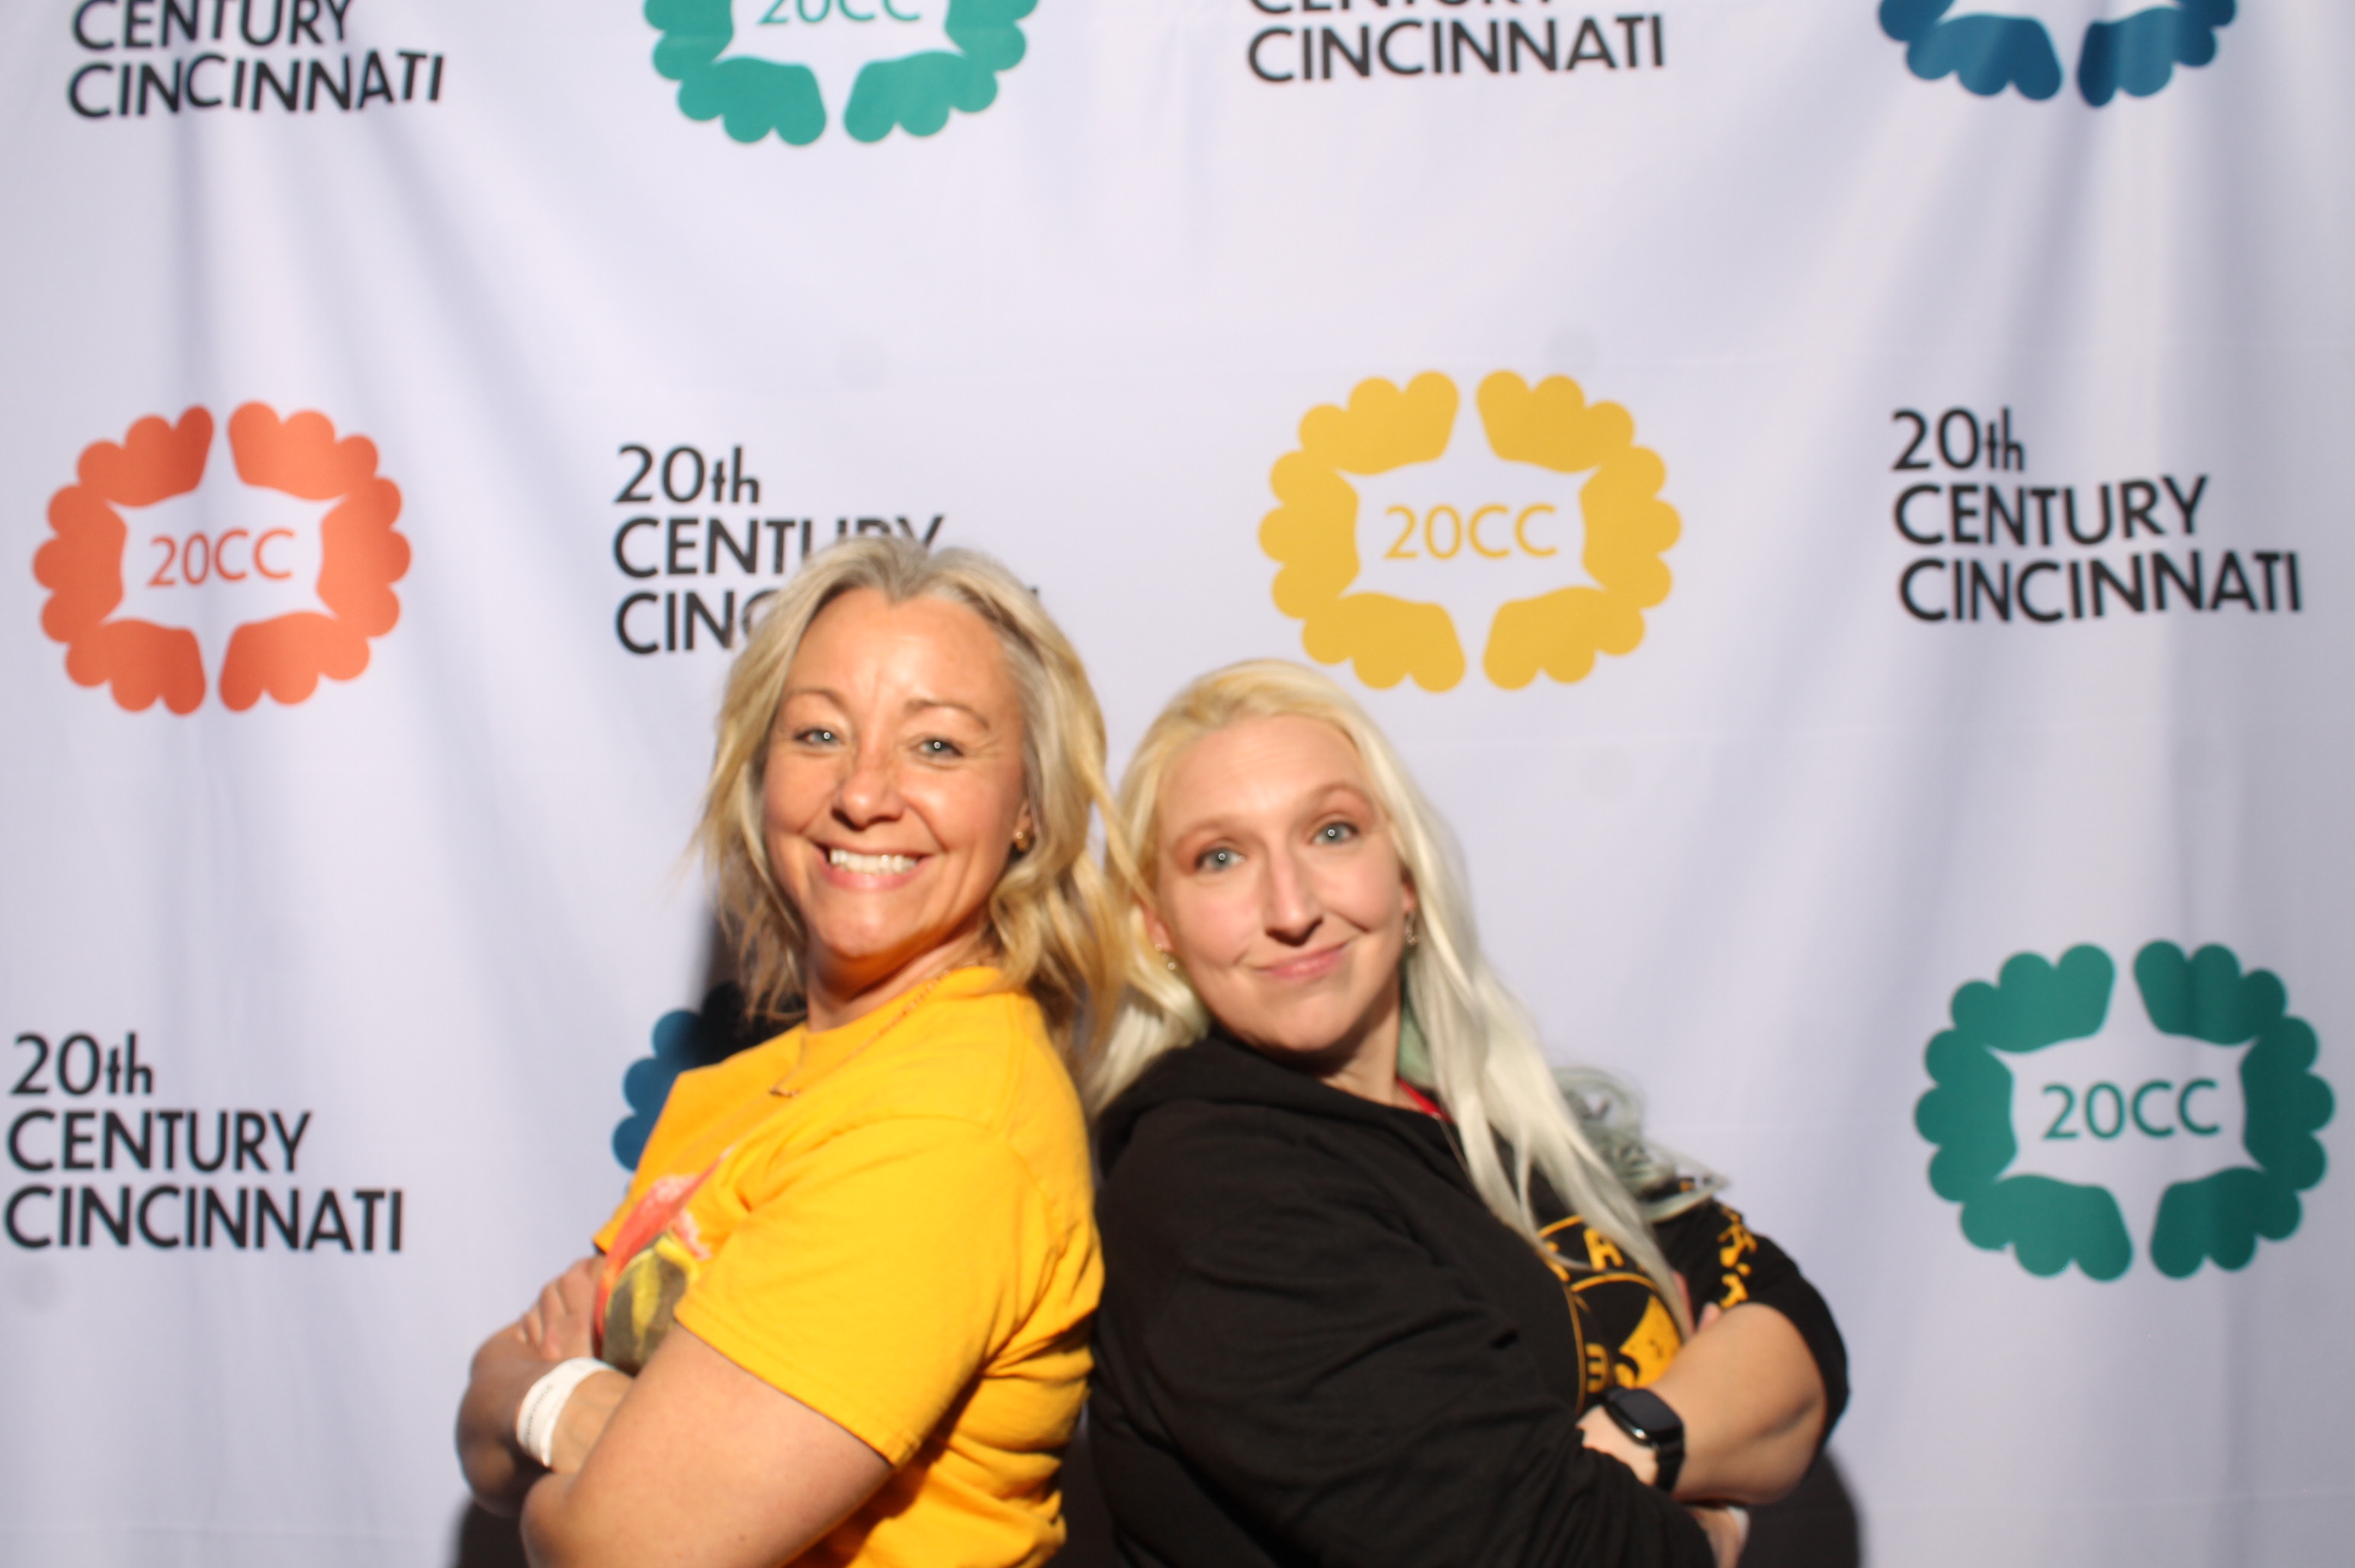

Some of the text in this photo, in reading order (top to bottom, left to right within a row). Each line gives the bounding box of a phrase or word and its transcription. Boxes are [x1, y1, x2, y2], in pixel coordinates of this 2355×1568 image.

[71, 0, 352, 51] CENTURY
[1247, 14, 1664, 82] CINCINNATI
[66, 50, 445, 119] CINCINNATI
[1891, 406, 2026, 473] 20th
[614, 444, 760, 504] 20th
[1383, 503, 1558, 561] 20CC
[1893, 474, 2209, 548] CENTURY
[148, 528, 295, 587] 20CC
[613, 515, 946, 579] CENT
[1898, 548, 2303, 624] CINCINNATI
[9, 1031, 154, 1097] 20th
[6, 1107, 312, 1174] CENTURY
[2041, 1079, 2222, 1140] 20CC
[3, 1183, 403, 1253] CINCINNATI
